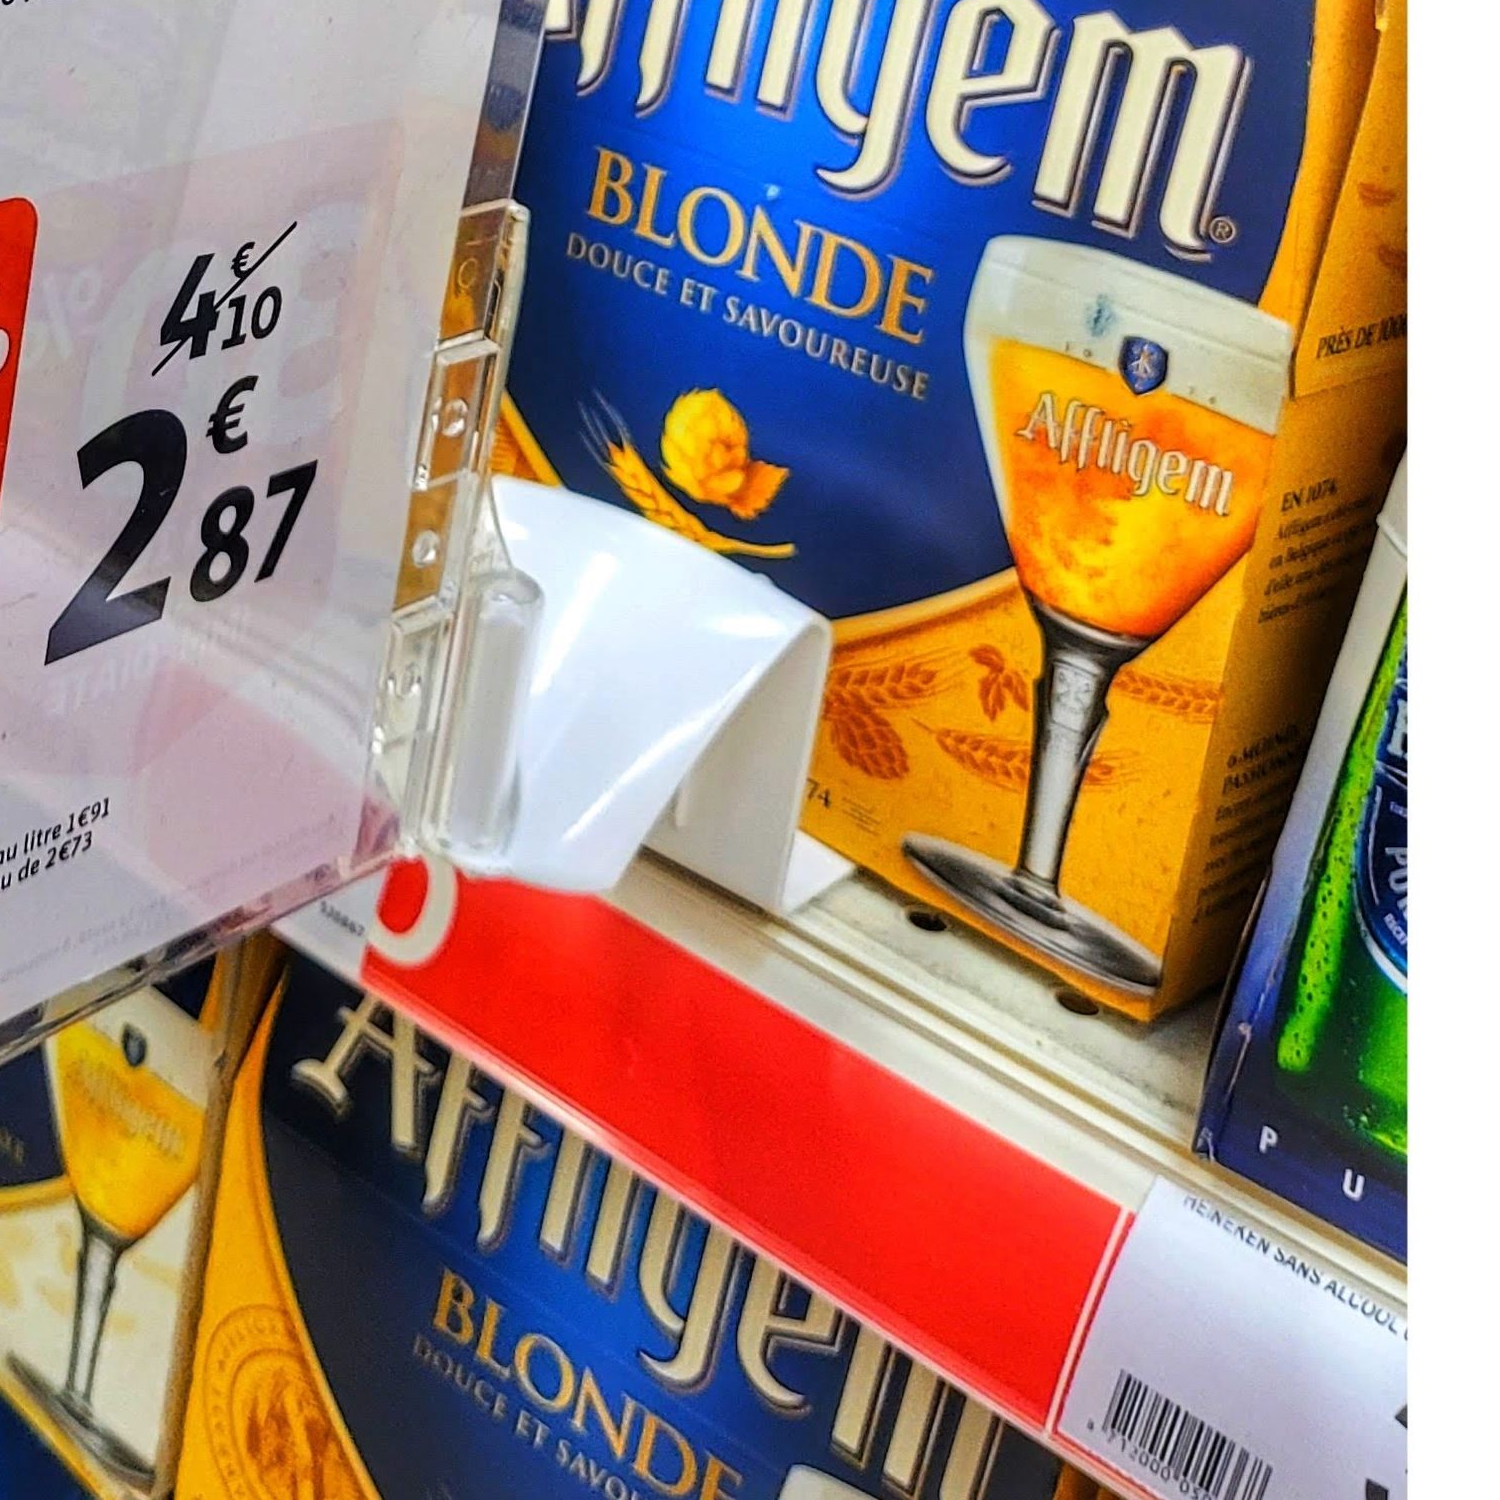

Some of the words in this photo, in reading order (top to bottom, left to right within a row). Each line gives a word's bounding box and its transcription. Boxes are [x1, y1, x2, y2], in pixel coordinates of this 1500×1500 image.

[586, 146, 934, 346] BLONDE
[565, 232, 672, 296] DOUCE
[678, 276, 719, 314] ET
[722, 295, 931, 400] SAVOUREUSE
[1016, 391, 1234, 518] Affligem
[17, 857, 41, 883] de
[44, 830, 93, 870] 2€73
[23, 822, 62, 854] litre
[66, 796, 110, 835] 1€91
[1182, 1194, 1271, 1254] HEINEKEN
[1273, 1246, 1323, 1286] SANS
[1322, 1277, 1399, 1333] ALCOOL
[412, 1334, 509, 1419] DOUCE
[514, 1409, 551, 1450] ET
[432, 1265, 744, 1500] BLONDE
